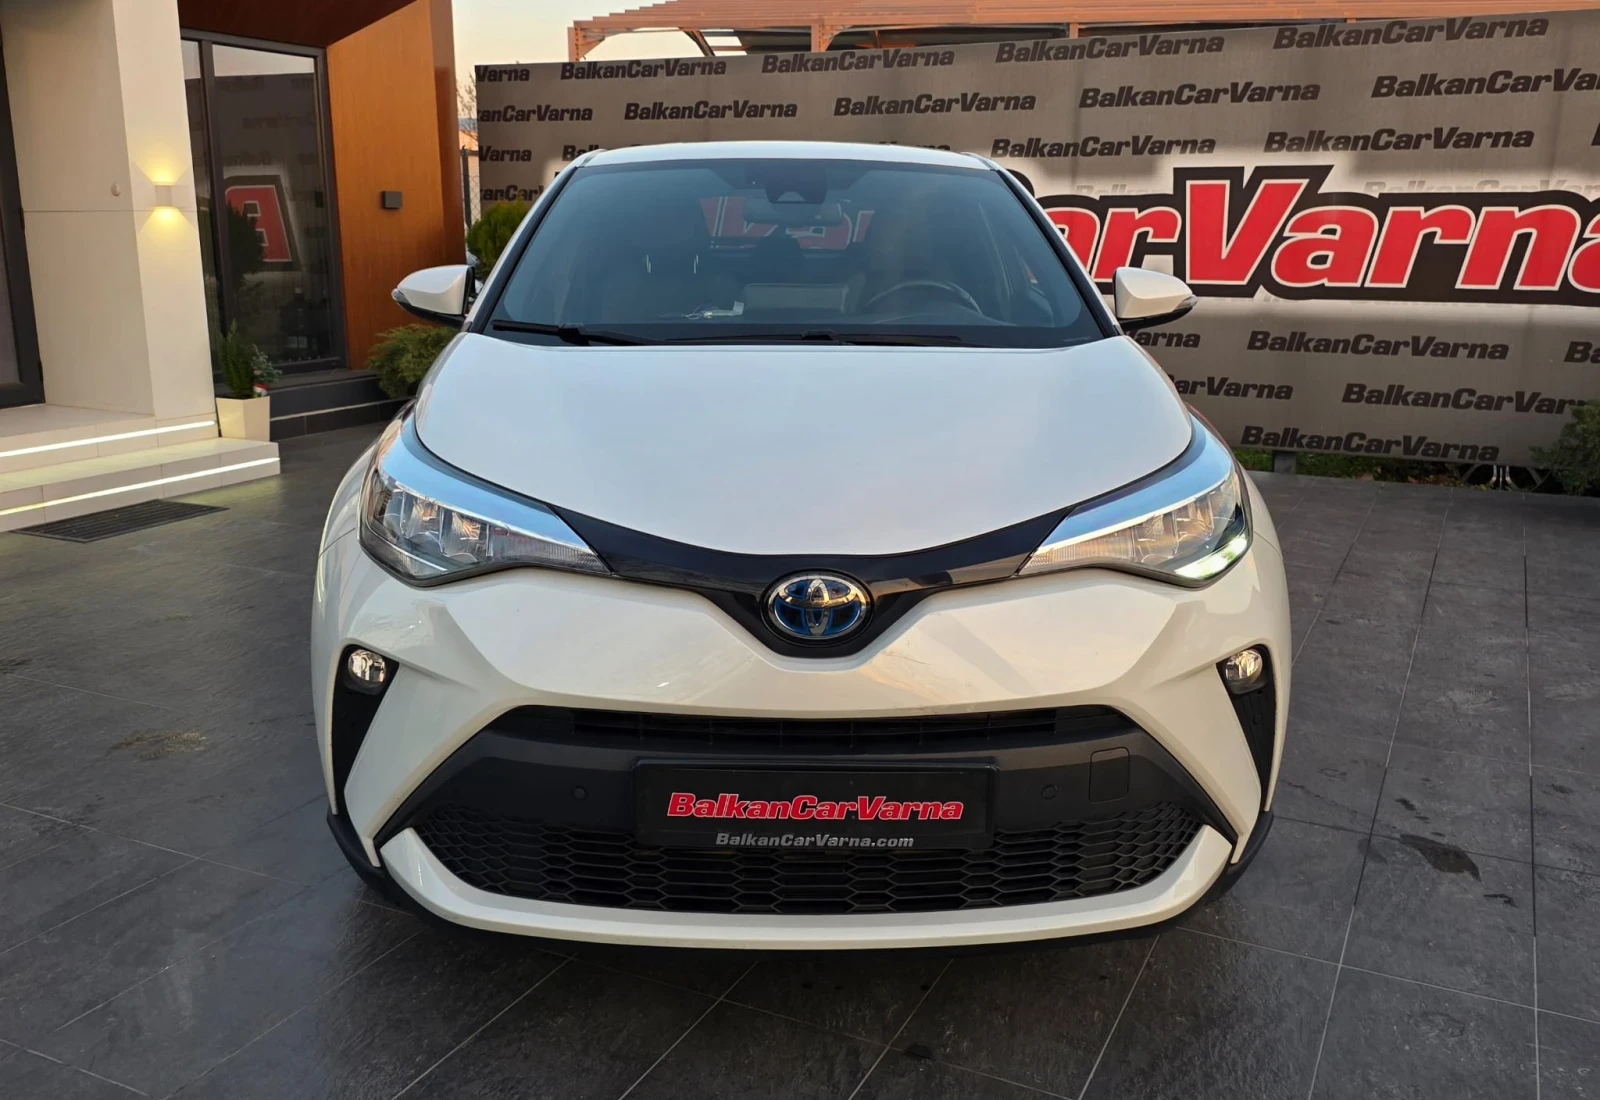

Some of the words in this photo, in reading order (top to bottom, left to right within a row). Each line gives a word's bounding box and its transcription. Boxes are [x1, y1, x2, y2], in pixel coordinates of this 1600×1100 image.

[1272, 17, 1549, 50] BalkanCarVarna
[761, 50, 954, 74] BalkanCarVarna
[995, 35, 1225, 64] BalkanCarVarna
[560, 60, 727, 80] BalkanCarVarna
[1371, 68, 1600, 98] BalkanCarVa
[834, 93, 1037, 117] BalkanCarVarna
[1079, 83, 1321, 109] BalkanCarVarna
[624, 100, 798, 121] BalkanCarVarna
[991, 135, 1216, 158] BalkanCarVarna
[1264, 127, 1535, 153] BalkanCarVarna
[1124, 329, 1201, 348] arna
[1247, 331, 1509, 360] BalkanCarVarna
[1167, 373, 1293, 400] arVarna
[1241, 425, 1499, 461] BalkanCarVarna
[667, 792, 963, 820] BalkanCarVarna
[715, 833, 914, 848] BalkanCarVarna.com
